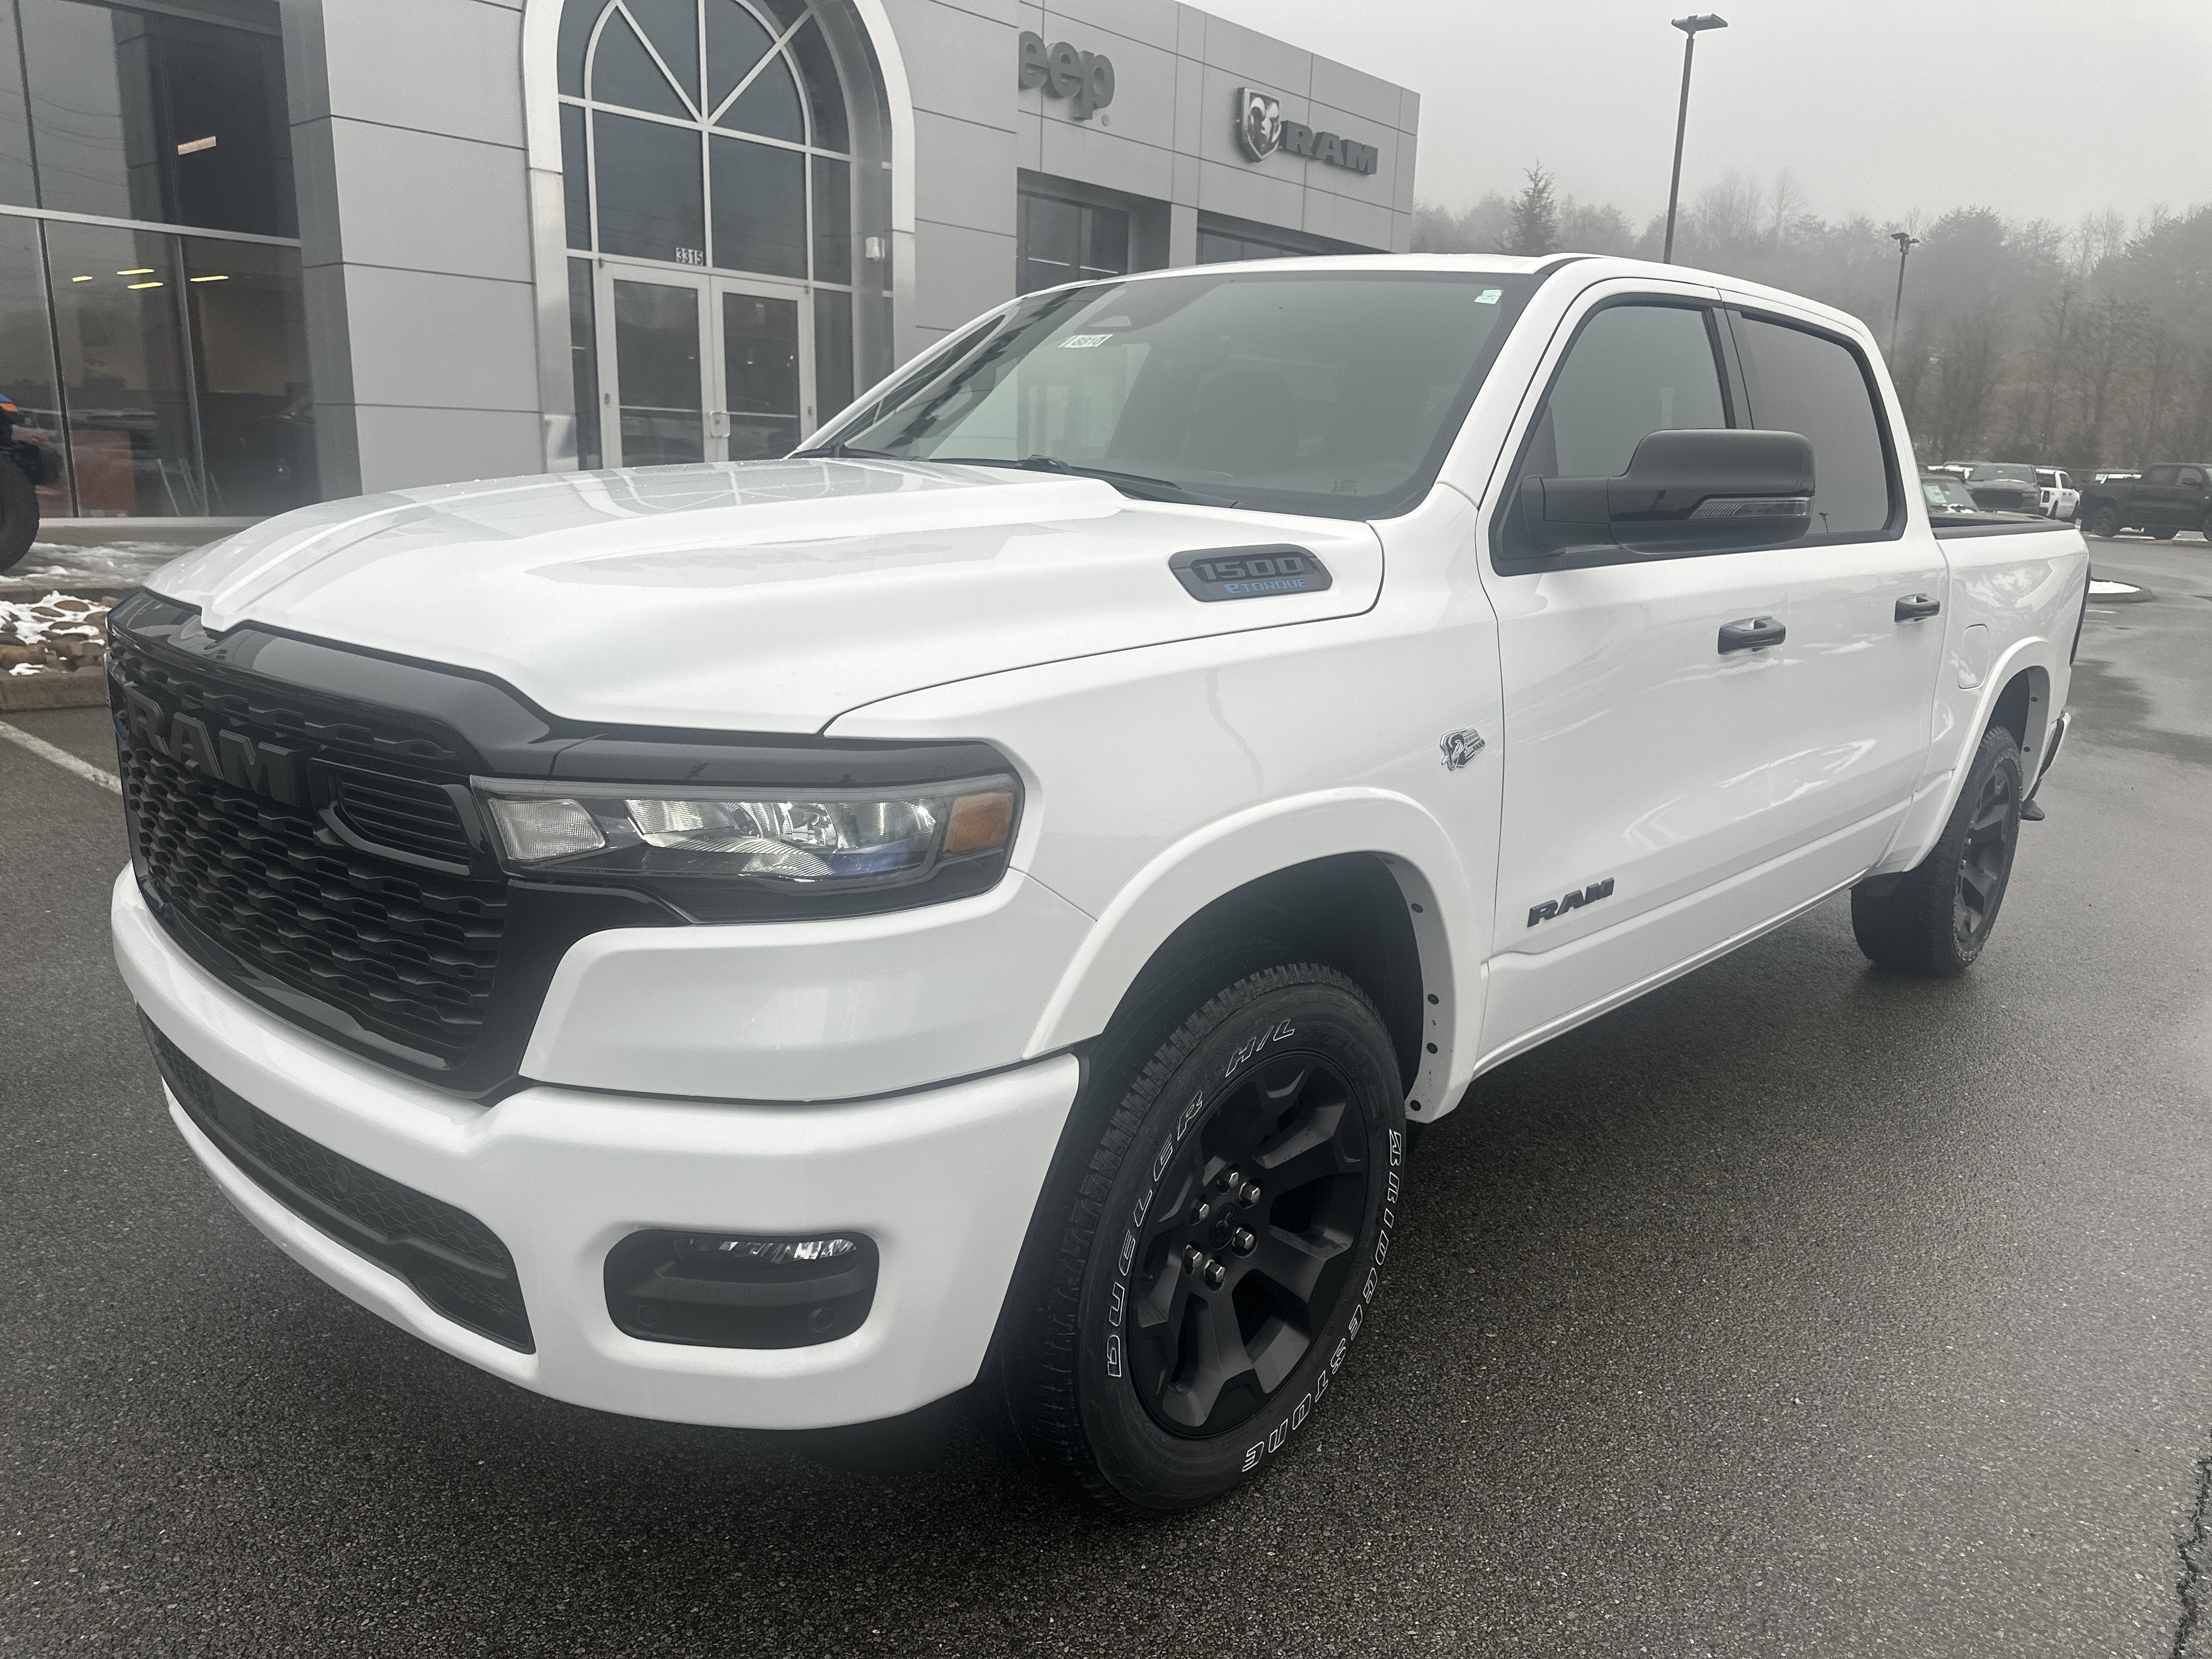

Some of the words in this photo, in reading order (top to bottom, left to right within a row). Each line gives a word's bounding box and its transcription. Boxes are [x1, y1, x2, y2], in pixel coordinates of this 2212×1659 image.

[1018, 31, 1115, 121] eep
[1280, 120, 1378, 175] RAM
[676, 249, 704, 266] 3315
[1195, 557, 1305, 580] 1500
[125, 683, 301, 808] RAM
[1527, 877, 1615, 928] RAM
[1106, 1091, 1203, 1378] DUELER
[1224, 1018, 1296, 1079] H/L
[1241, 1128, 1403, 1474] BRIDGESTONE
